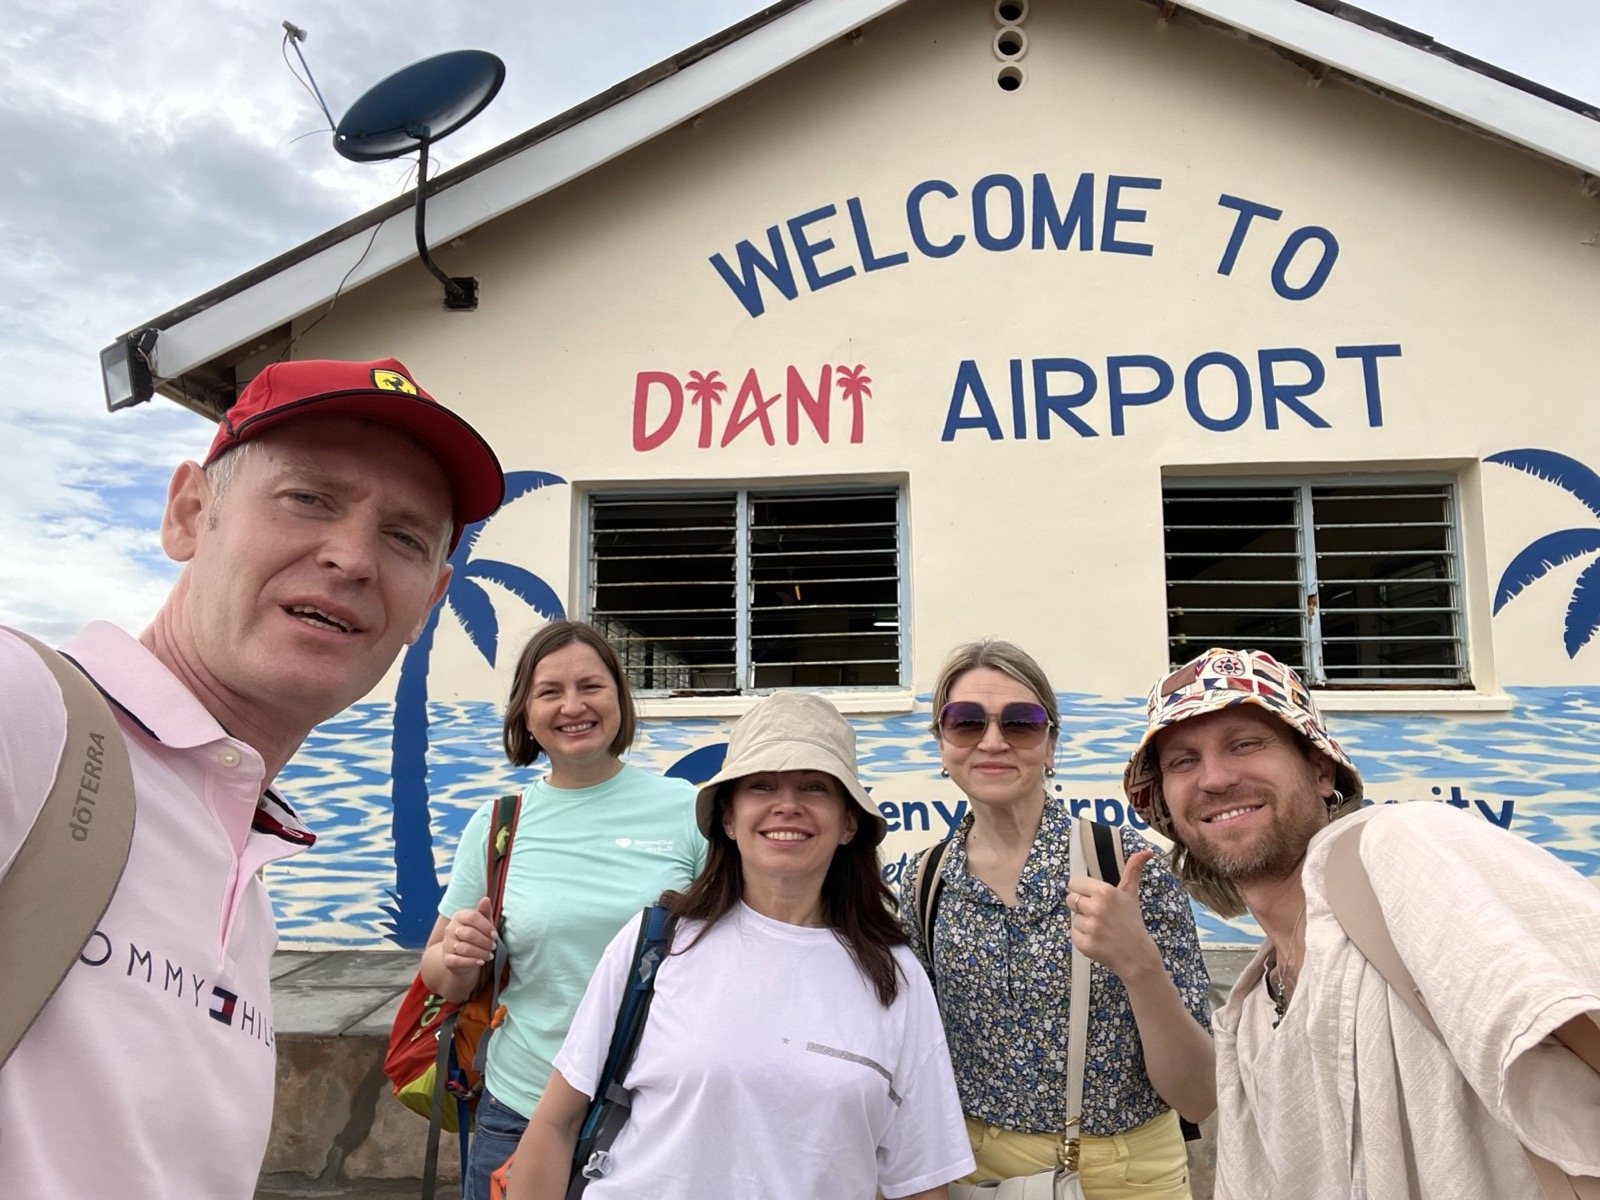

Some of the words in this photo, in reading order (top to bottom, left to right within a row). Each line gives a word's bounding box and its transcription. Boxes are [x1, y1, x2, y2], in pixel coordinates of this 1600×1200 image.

[710, 174, 1162, 317] WELCOME
[1218, 193, 1339, 301] TO
[632, 363, 873, 452] DIANI
[942, 343, 1402, 442] AIRPORT
[80, 930, 206, 1008] OMMY
